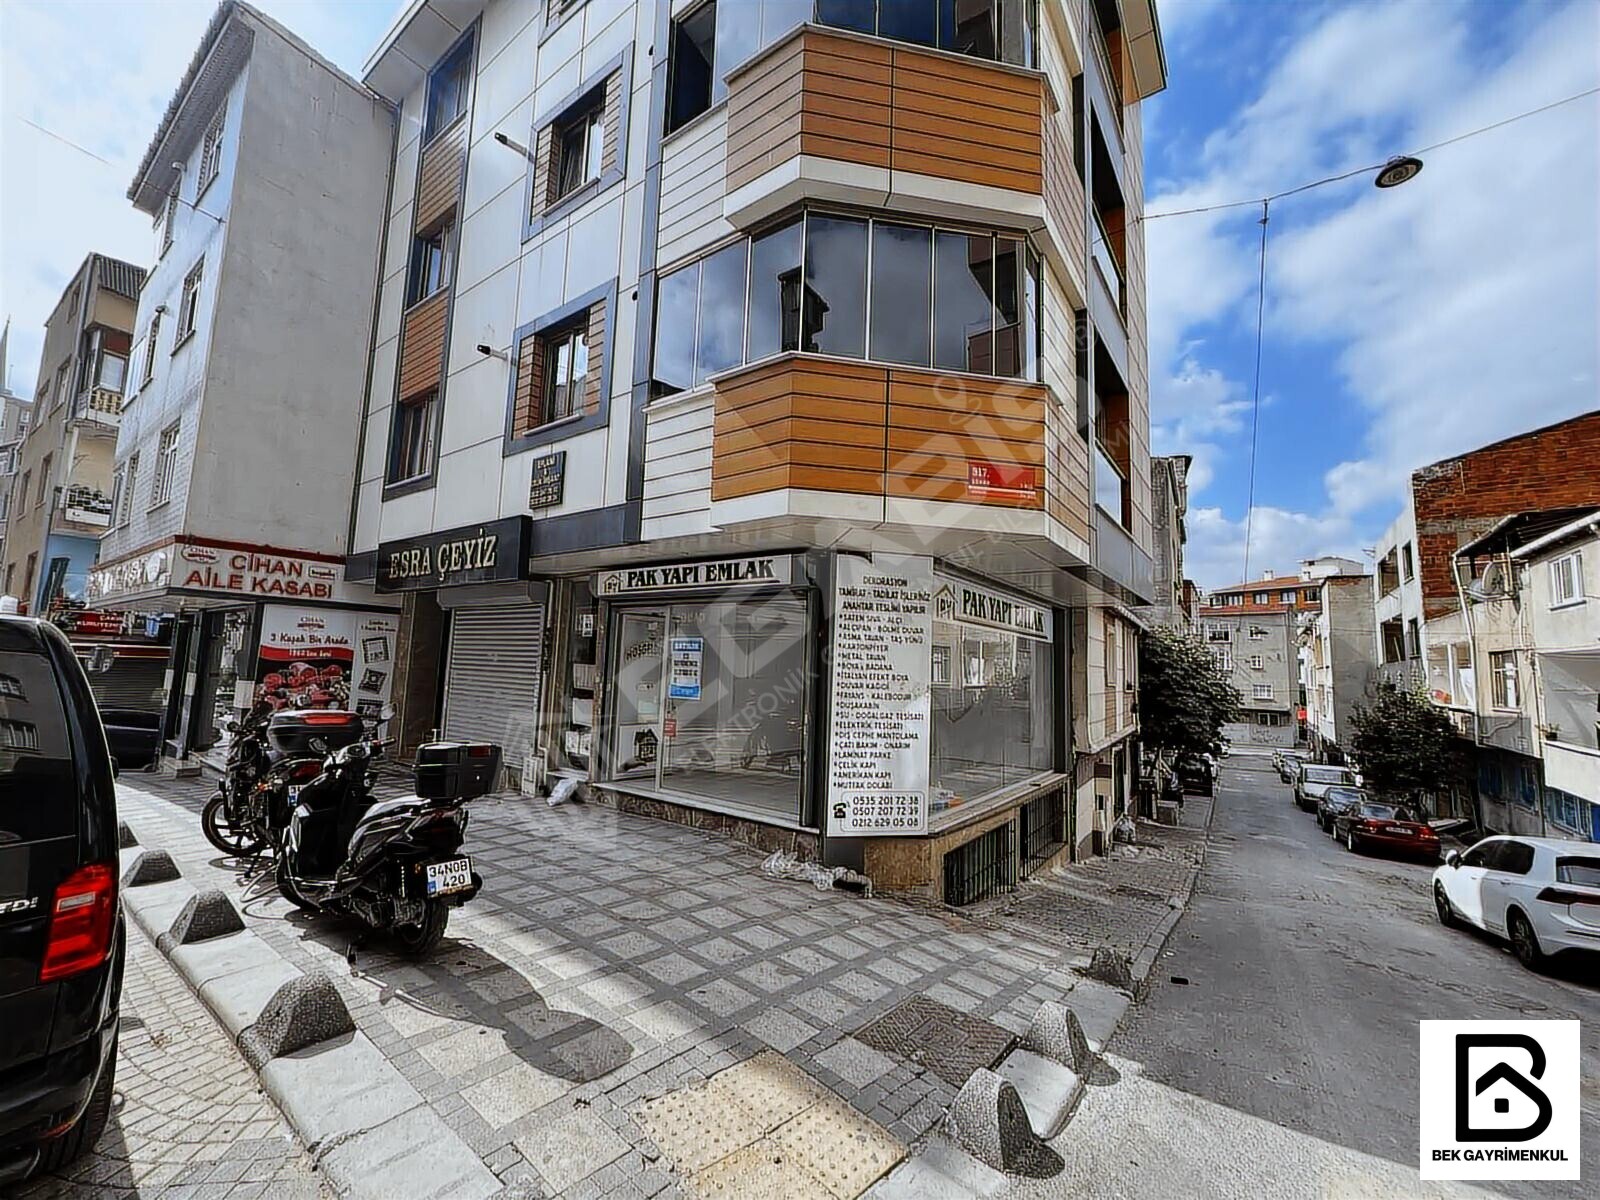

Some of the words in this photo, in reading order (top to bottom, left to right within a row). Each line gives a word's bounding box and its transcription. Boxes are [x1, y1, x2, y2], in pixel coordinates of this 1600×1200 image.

[388, 547, 431, 579] ESRA
[437, 527, 497, 581] ÇEYİZ
[230, 553, 303, 578] CİHAN
[627, 570, 660, 588] PAK
[661, 565, 700, 585] YAPI
[705, 560, 774, 582] EMLAK
[184, 567, 244, 590] AİLE
[252, 576, 333, 599] KASABI
[863, 576, 908, 587] DEKORASYON
[873, 588, 898, 599] TADİLAT
[842, 601, 874, 611] ANAHTAR
[902, 604, 926, 614] YAPILIR
[962, 588, 987, 619] PAK
[987, 596, 1012, 625] YAPI
[842, 652, 864, 660] METAL
[877, 732, 919, 740] MANTOLAMA
[878, 796, 893, 805] 201
[896, 796, 906, 805] 72
[852, 806, 875, 815] 0507
[878, 806, 893, 815] 207
[896, 806, 906, 815] 72
[852, 818, 872, 827] 0212
[874, 818, 890, 827] 629
[893, 818, 905, 827] 05
[442, 874, 466, 888] 420
